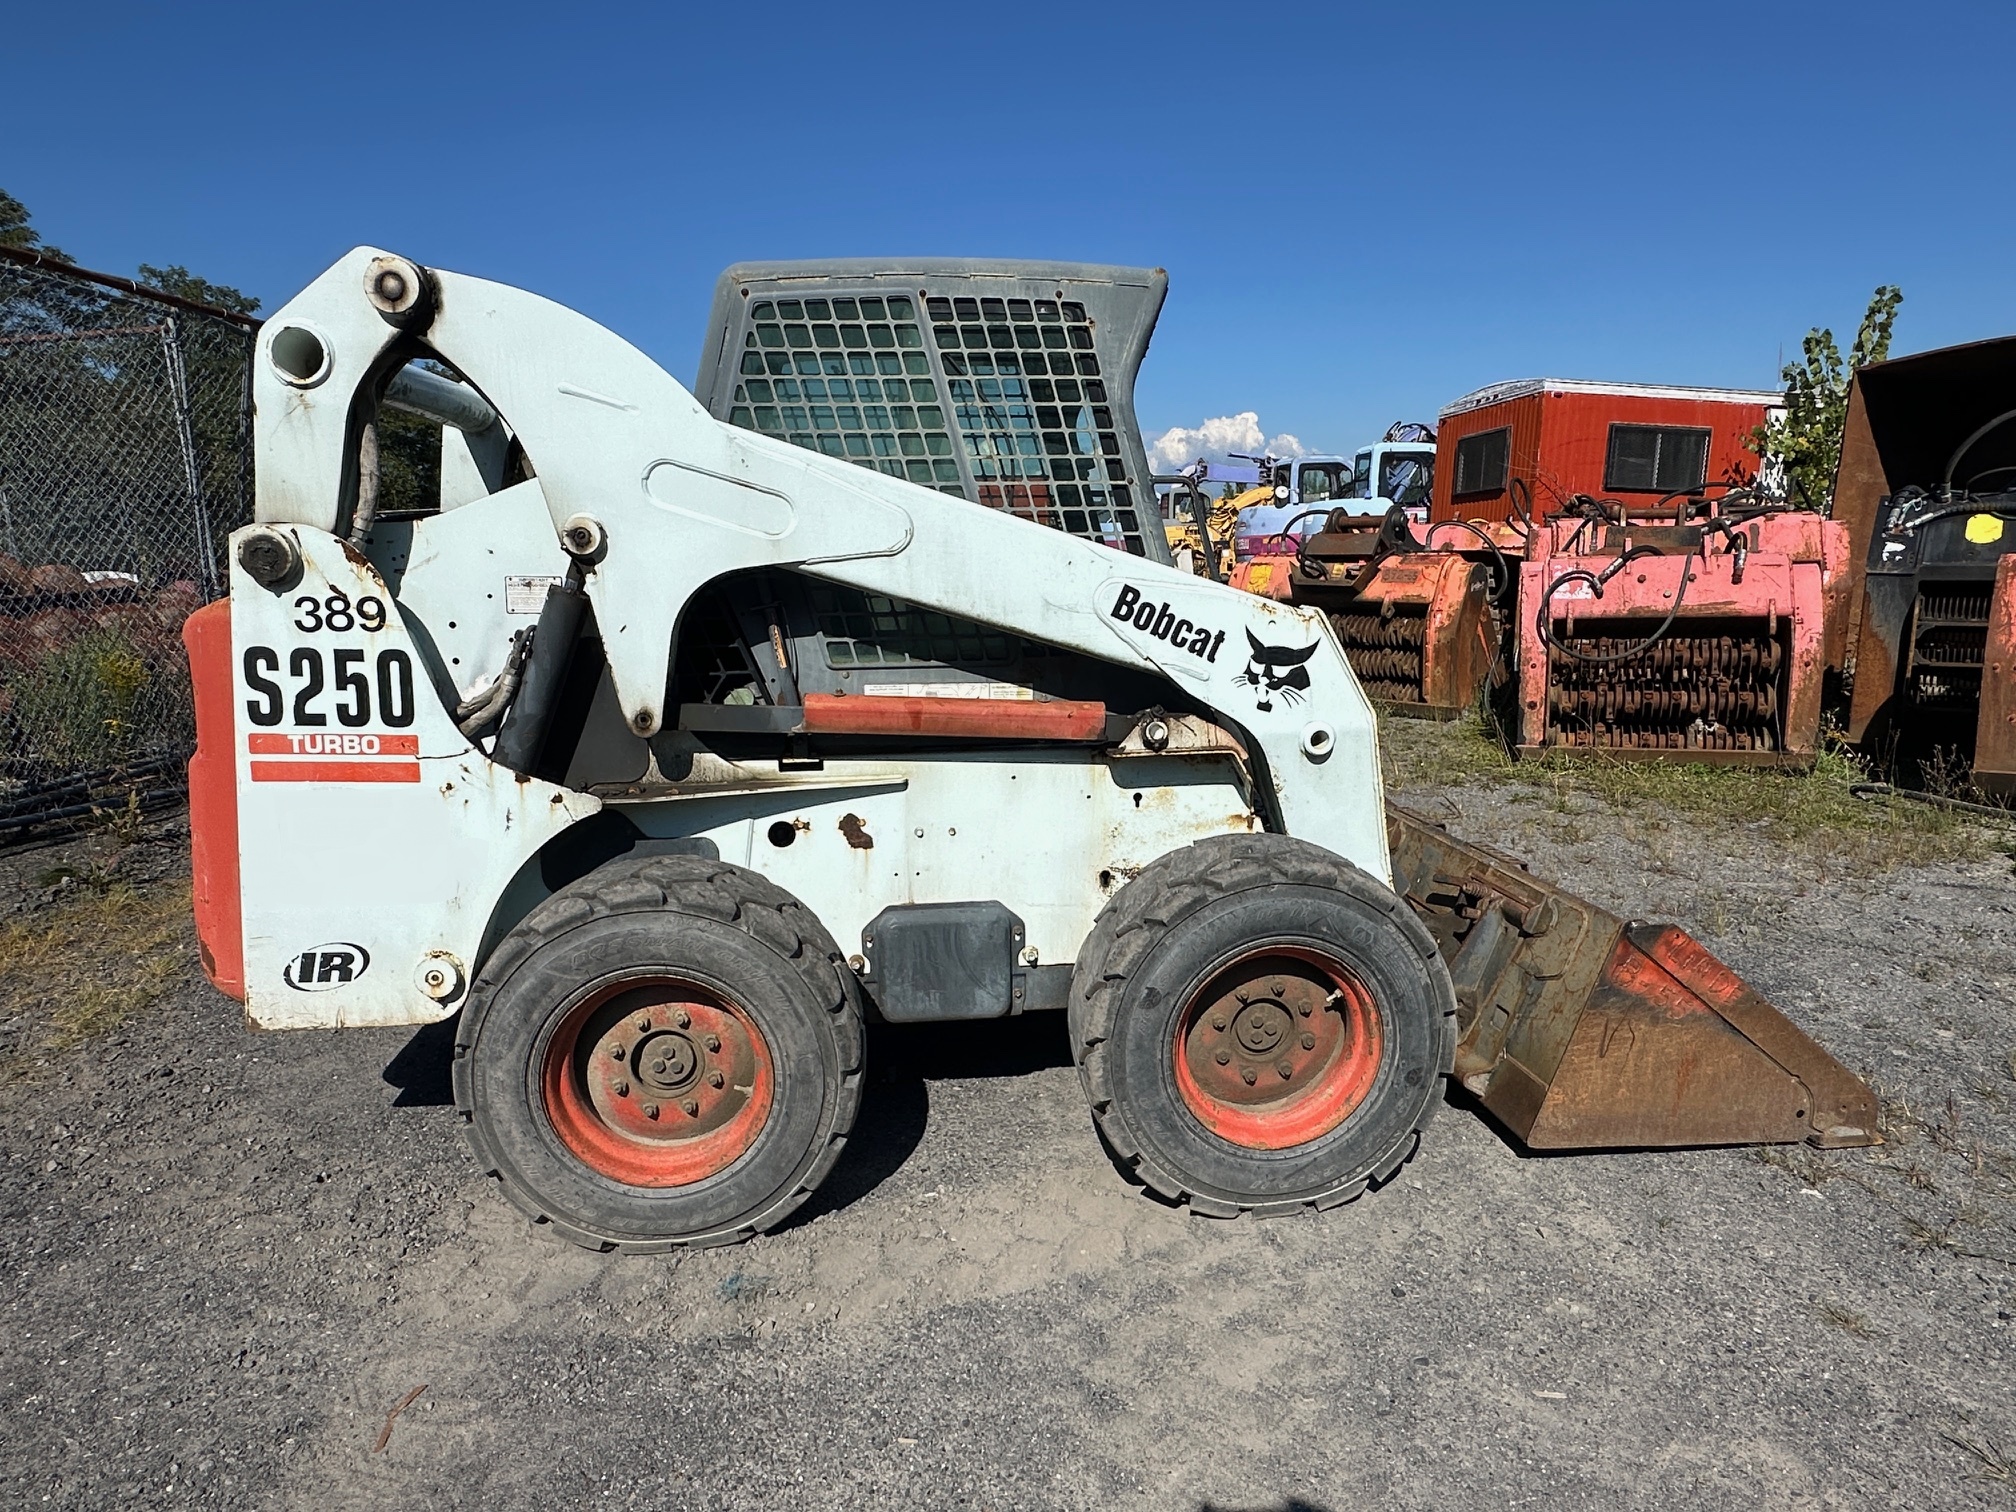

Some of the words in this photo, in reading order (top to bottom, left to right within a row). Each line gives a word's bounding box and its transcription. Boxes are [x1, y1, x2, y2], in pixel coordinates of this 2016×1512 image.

[294, 595, 387, 633] 389
[1110, 584, 1226, 664] Bobcat
[243, 645, 415, 728] S250
[287, 734, 381, 754] TURBO
[297, 952, 355, 983] IR
